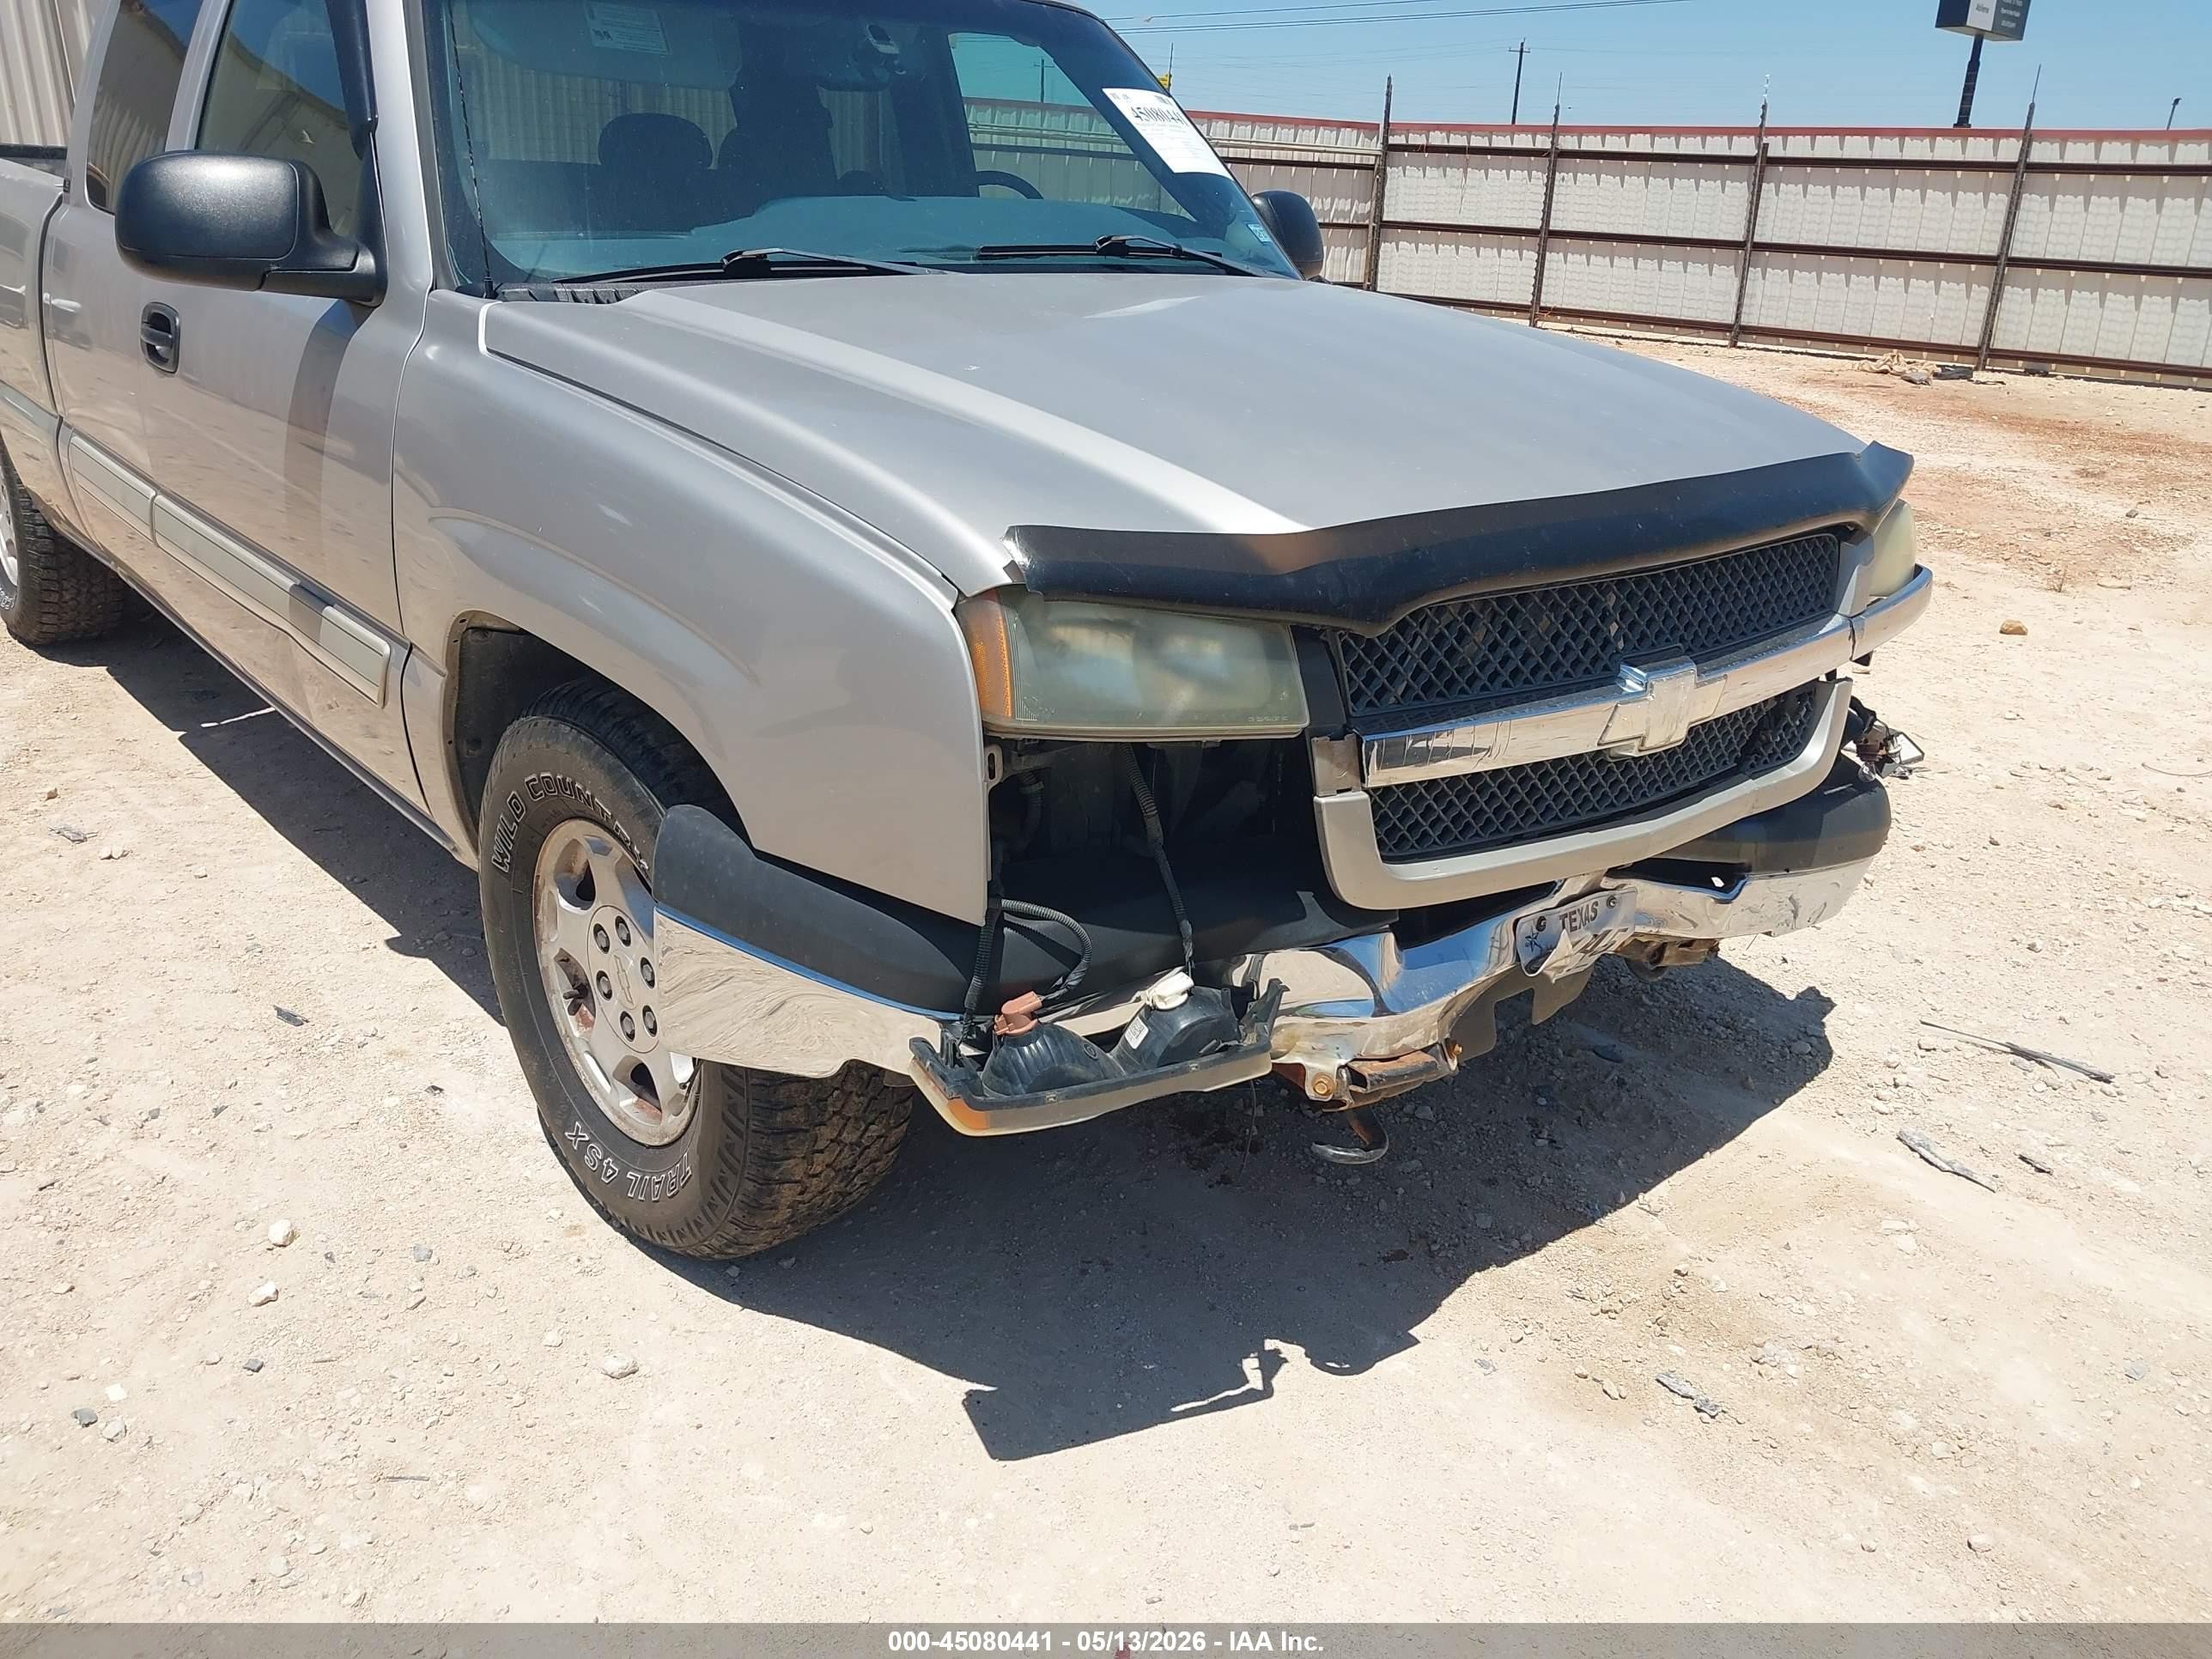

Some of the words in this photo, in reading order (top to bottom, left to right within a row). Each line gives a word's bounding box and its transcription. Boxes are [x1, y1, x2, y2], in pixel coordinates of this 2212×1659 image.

[492, 790, 526, 873] WILD
[1559, 900, 1599, 933] TEXAS
[564, 1121, 620, 1184] 4SX
[627, 1152, 693, 1203] TRAIL
